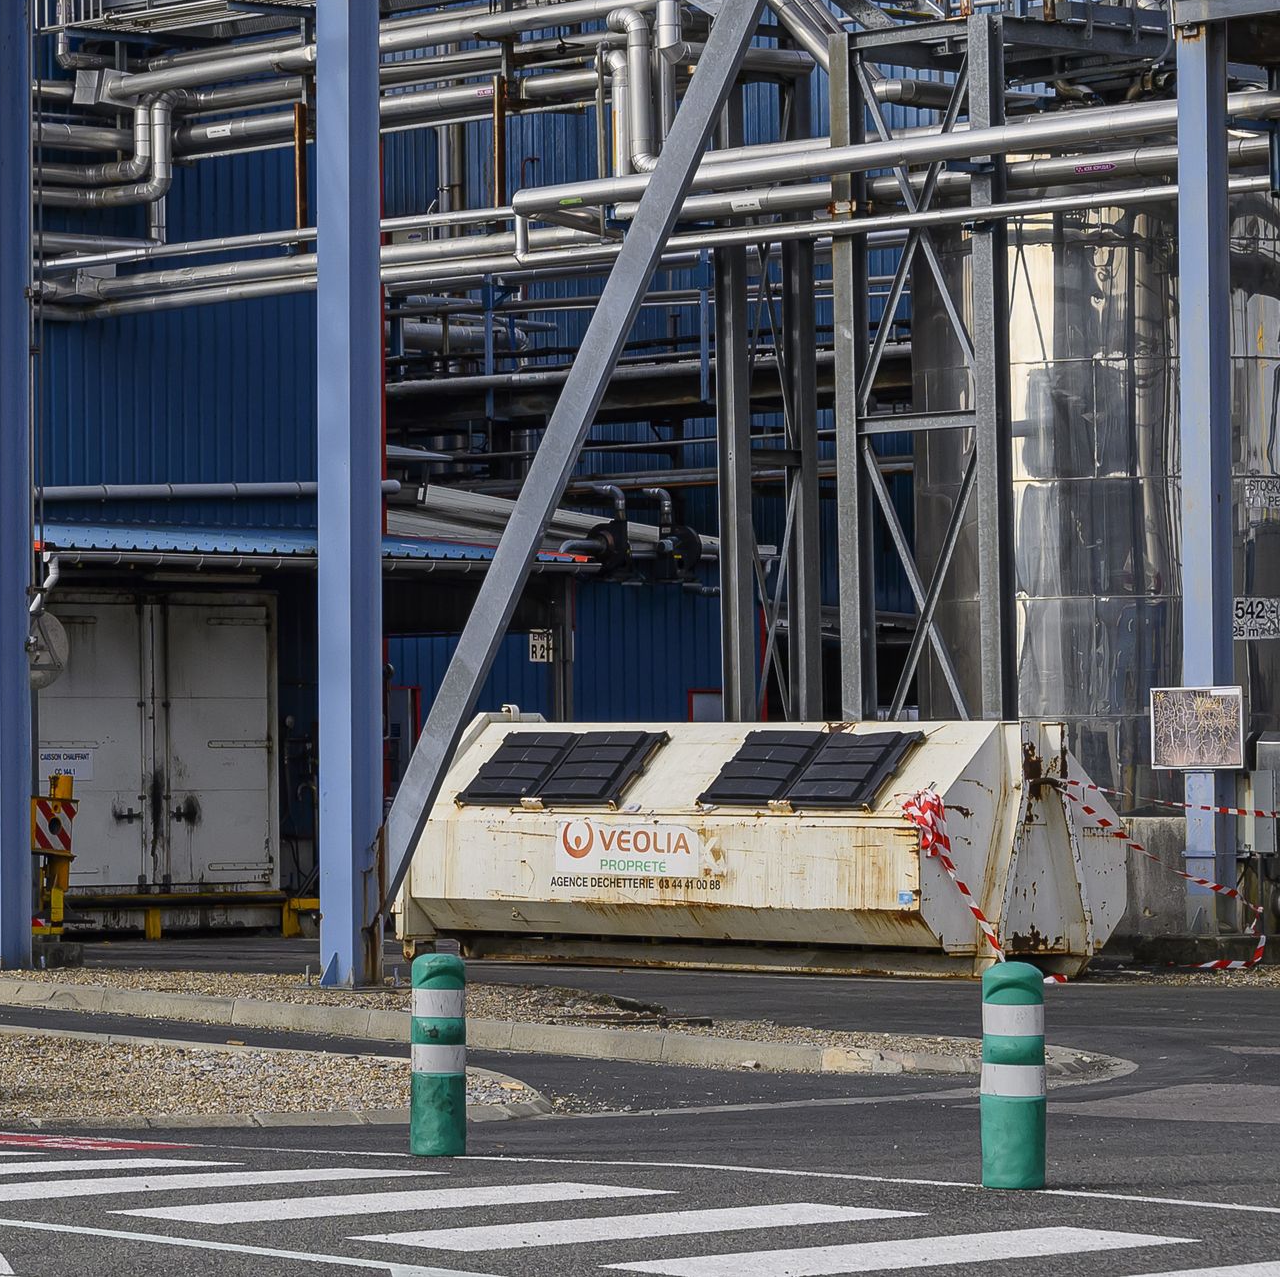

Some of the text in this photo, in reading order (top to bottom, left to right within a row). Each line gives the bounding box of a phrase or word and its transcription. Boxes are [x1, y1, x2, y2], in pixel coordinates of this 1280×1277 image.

[1249, 480, 1280, 492] STOCK
[1235, 601, 1265, 619] 542
[599, 829, 691, 854] VEOLIA
[550, 876, 721, 891] AGENCE DECHETTERIE 03 44 41 00 88
